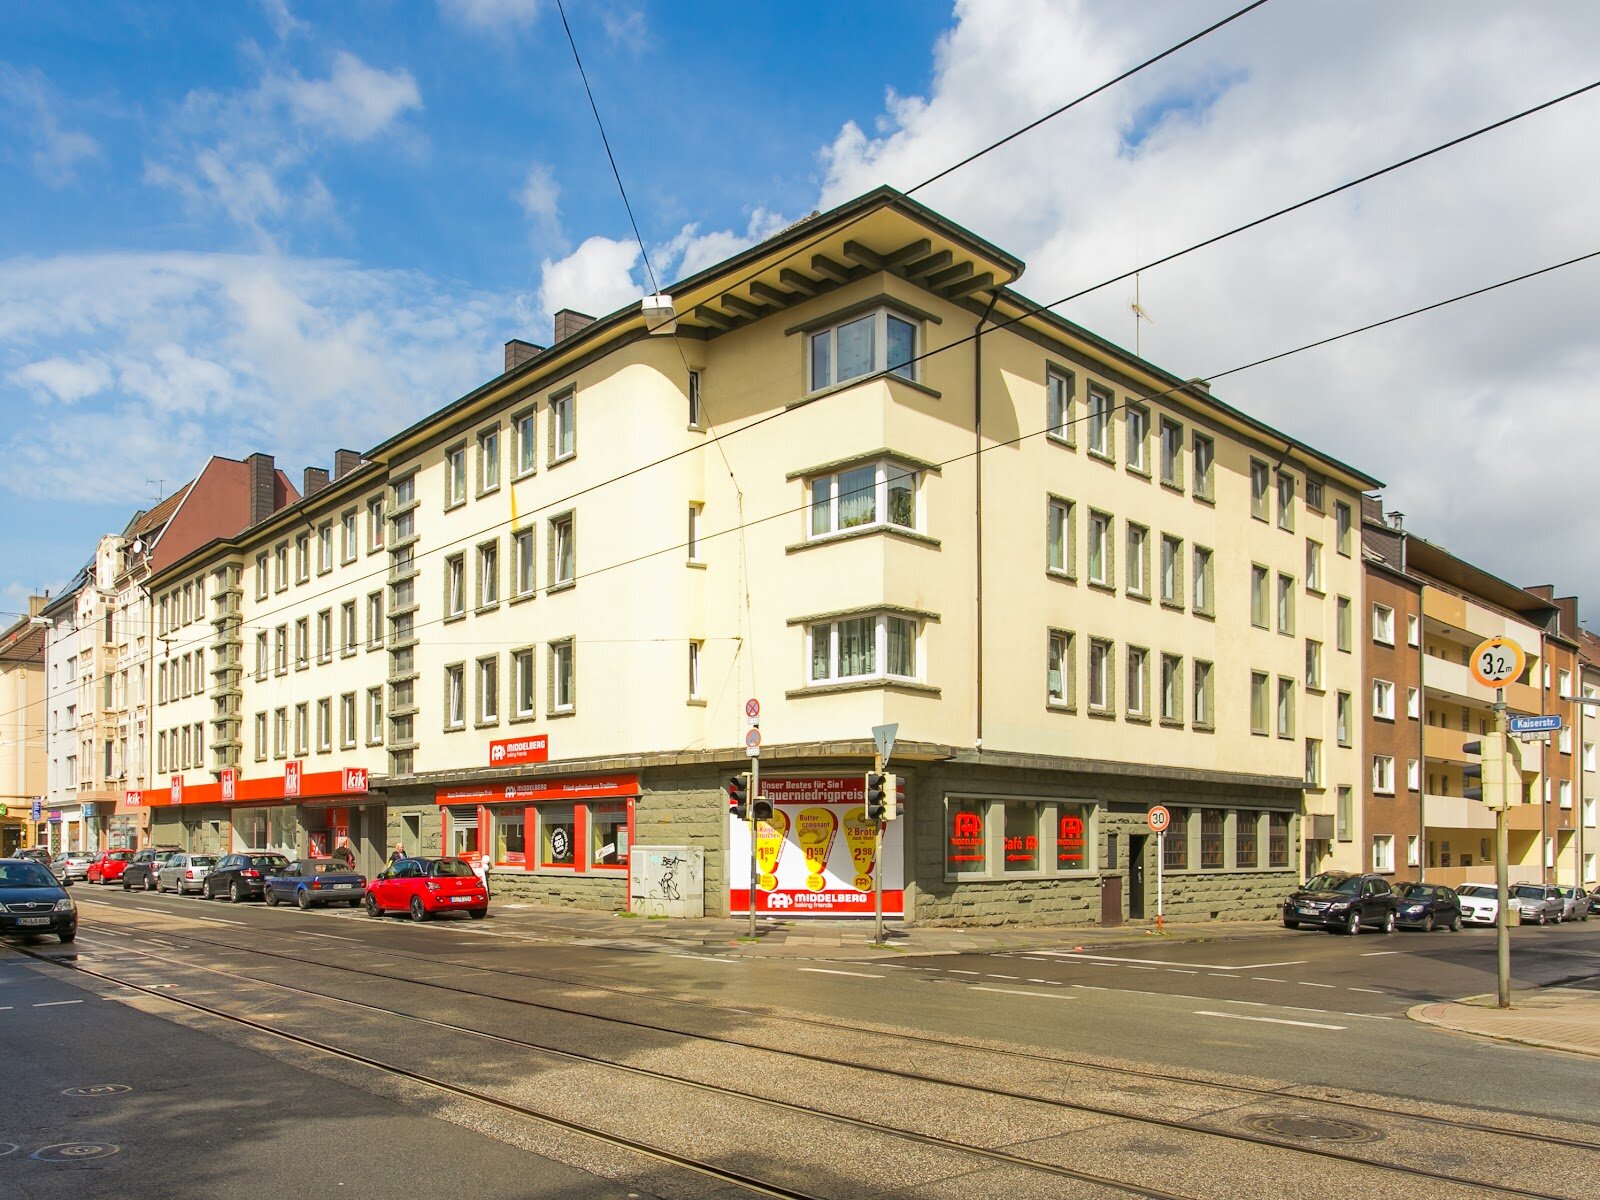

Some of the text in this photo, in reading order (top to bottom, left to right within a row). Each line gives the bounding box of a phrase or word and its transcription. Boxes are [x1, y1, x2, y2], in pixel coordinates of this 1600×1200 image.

[1517, 718, 1556, 728] Kaiserstr.
[506, 740, 546, 752] MIDDELBERG
[347, 768, 366, 788] kik
[516, 783, 547, 792] MIDDELBERG
[761, 781, 784, 789] Unser
[785, 781, 812, 789] Bestes
[813, 780, 825, 789] für
[127, 792, 141, 804] kik
[761, 789, 866, 802] Dauerniedrigpreis
[1152, 813, 1165, 825] 30
[847, 828, 853, 836] 2
[794, 893, 867, 903] MIDDELBERG
[794, 902, 813, 910] baking
